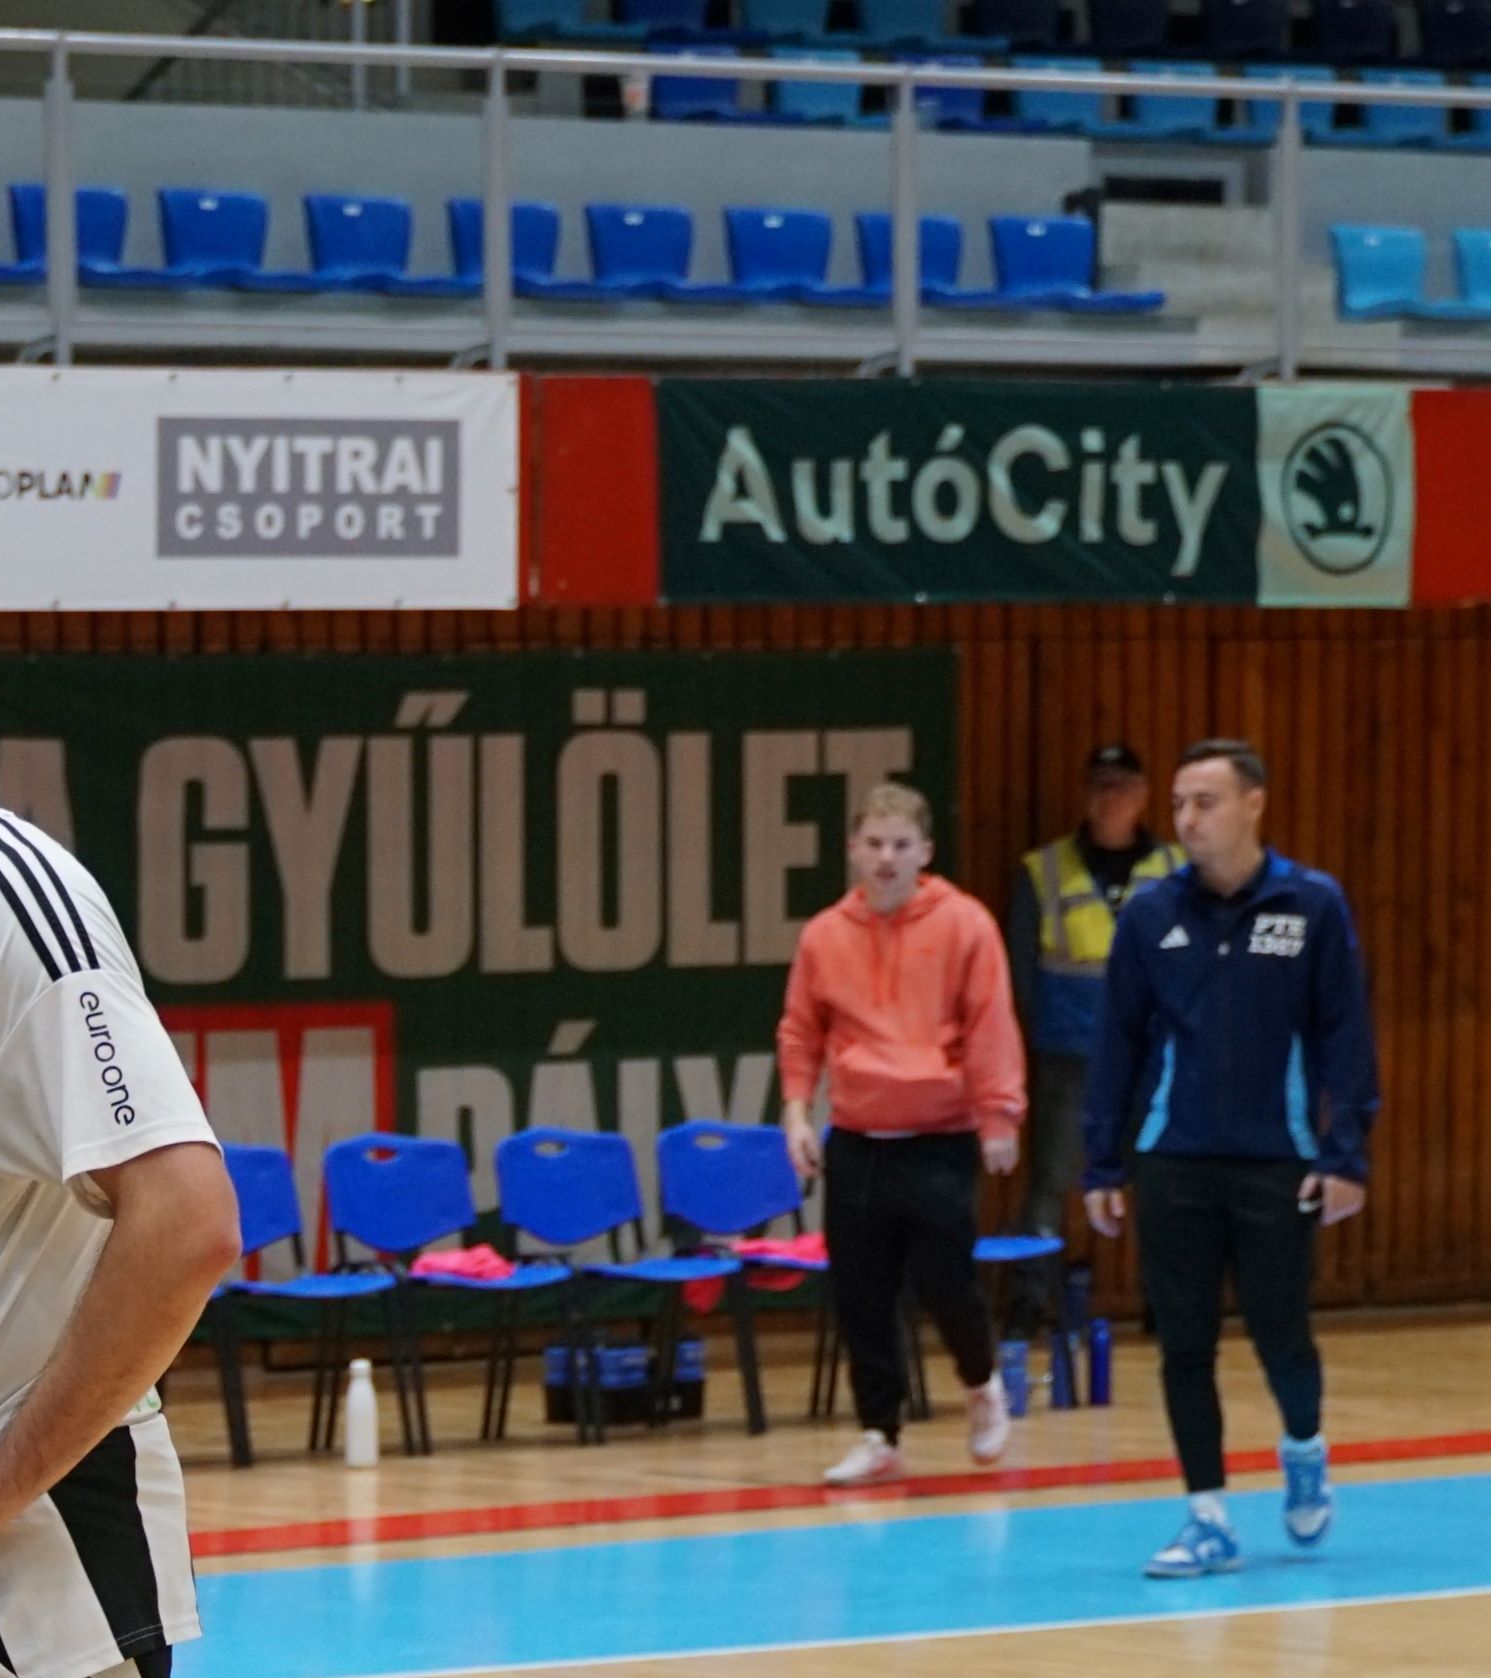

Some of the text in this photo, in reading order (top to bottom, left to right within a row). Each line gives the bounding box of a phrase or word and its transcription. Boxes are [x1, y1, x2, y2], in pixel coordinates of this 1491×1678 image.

[176, 435, 442, 494] NYITRAI
[699, 424, 1229, 578] AutóCity
[175, 504, 442, 540] CSOPORT
[137, 688, 913, 985] GYŰLÖLET
